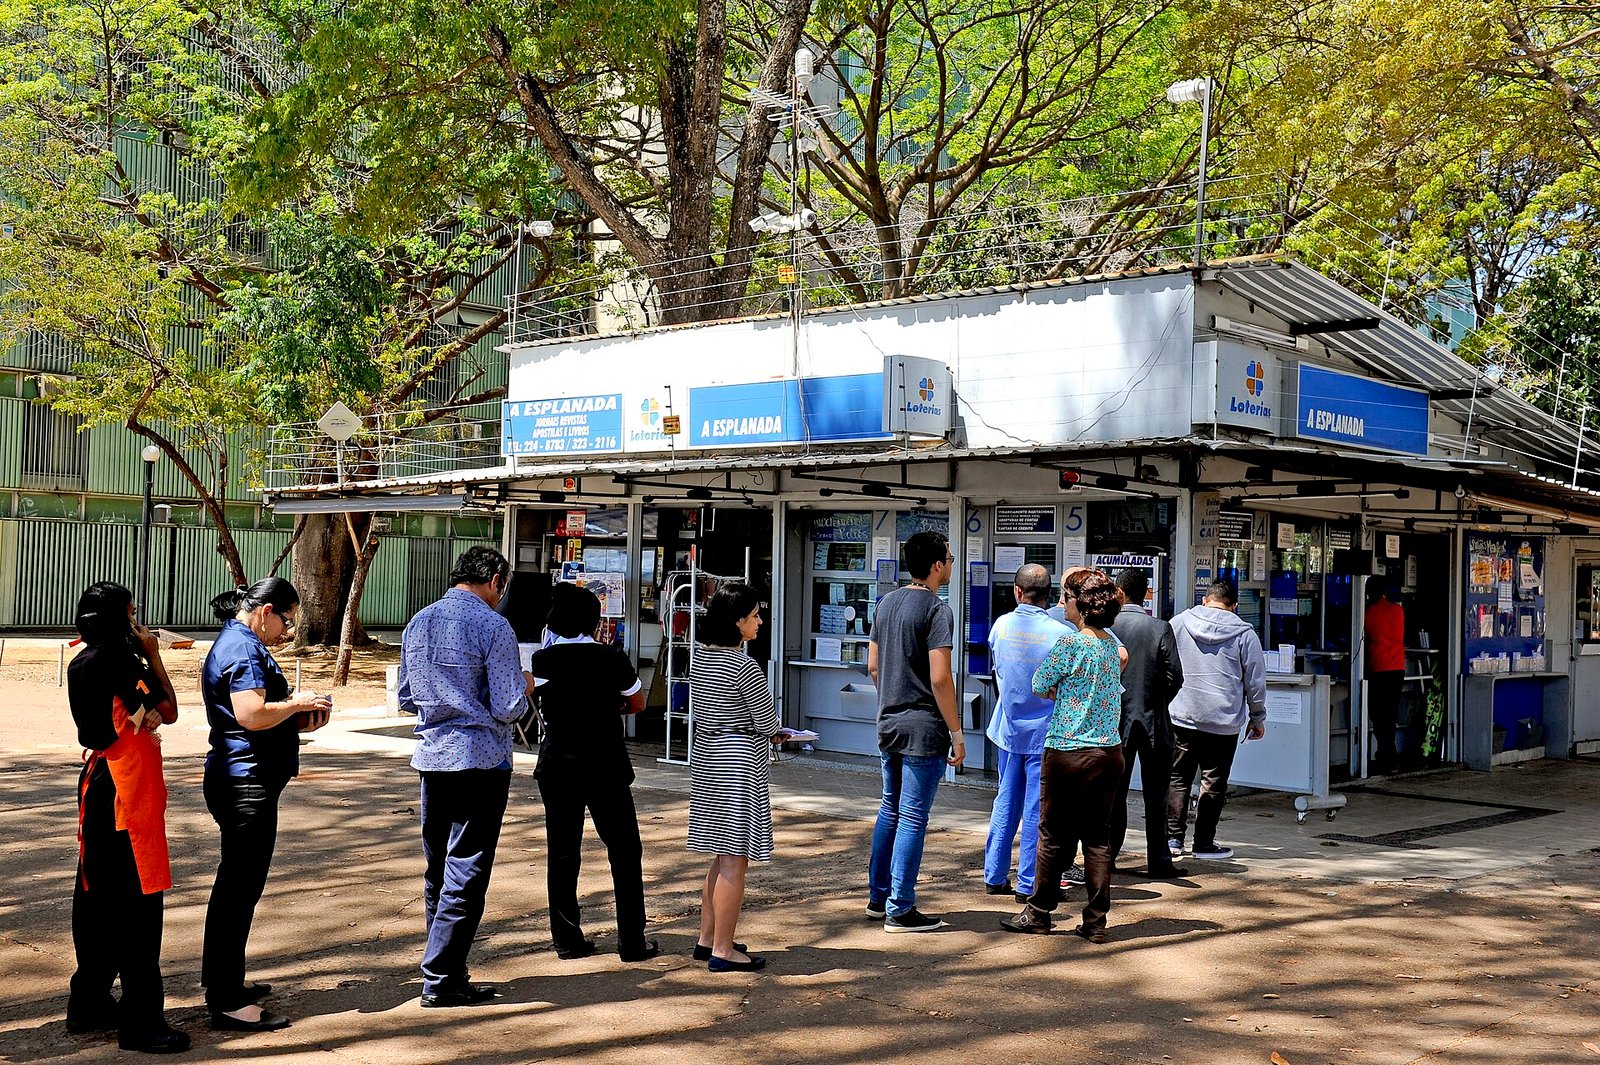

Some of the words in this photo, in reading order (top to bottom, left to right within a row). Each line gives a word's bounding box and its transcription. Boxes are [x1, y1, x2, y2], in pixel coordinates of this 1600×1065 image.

[510, 403, 520, 417] A
[523, 396, 617, 416] ESPLANADA
[906, 401, 942, 416] Loterias
[1230, 397, 1272, 418] Loterias
[560, 414, 588, 426] REVISTAS
[701, 420, 710, 438] A
[713, 415, 782, 437] ESPLANADA
[1306, 408, 1314, 428] A
[1316, 410, 1364, 437] ESPLANADA
[532, 427, 563, 439] APOSTILAS
[568, 425, 590, 437] LIVROS
[572, 438, 588, 450] 323
[594, 435, 616, 449] 2116
[630, 427, 673, 441] Loteria
[875, 509, 889, 531] 7
[967, 508, 981, 533] 6
[1065, 506, 1082, 531] 5
[1255, 516, 1265, 539] 4
[1096, 555, 1154, 566] ACUMULADAS
